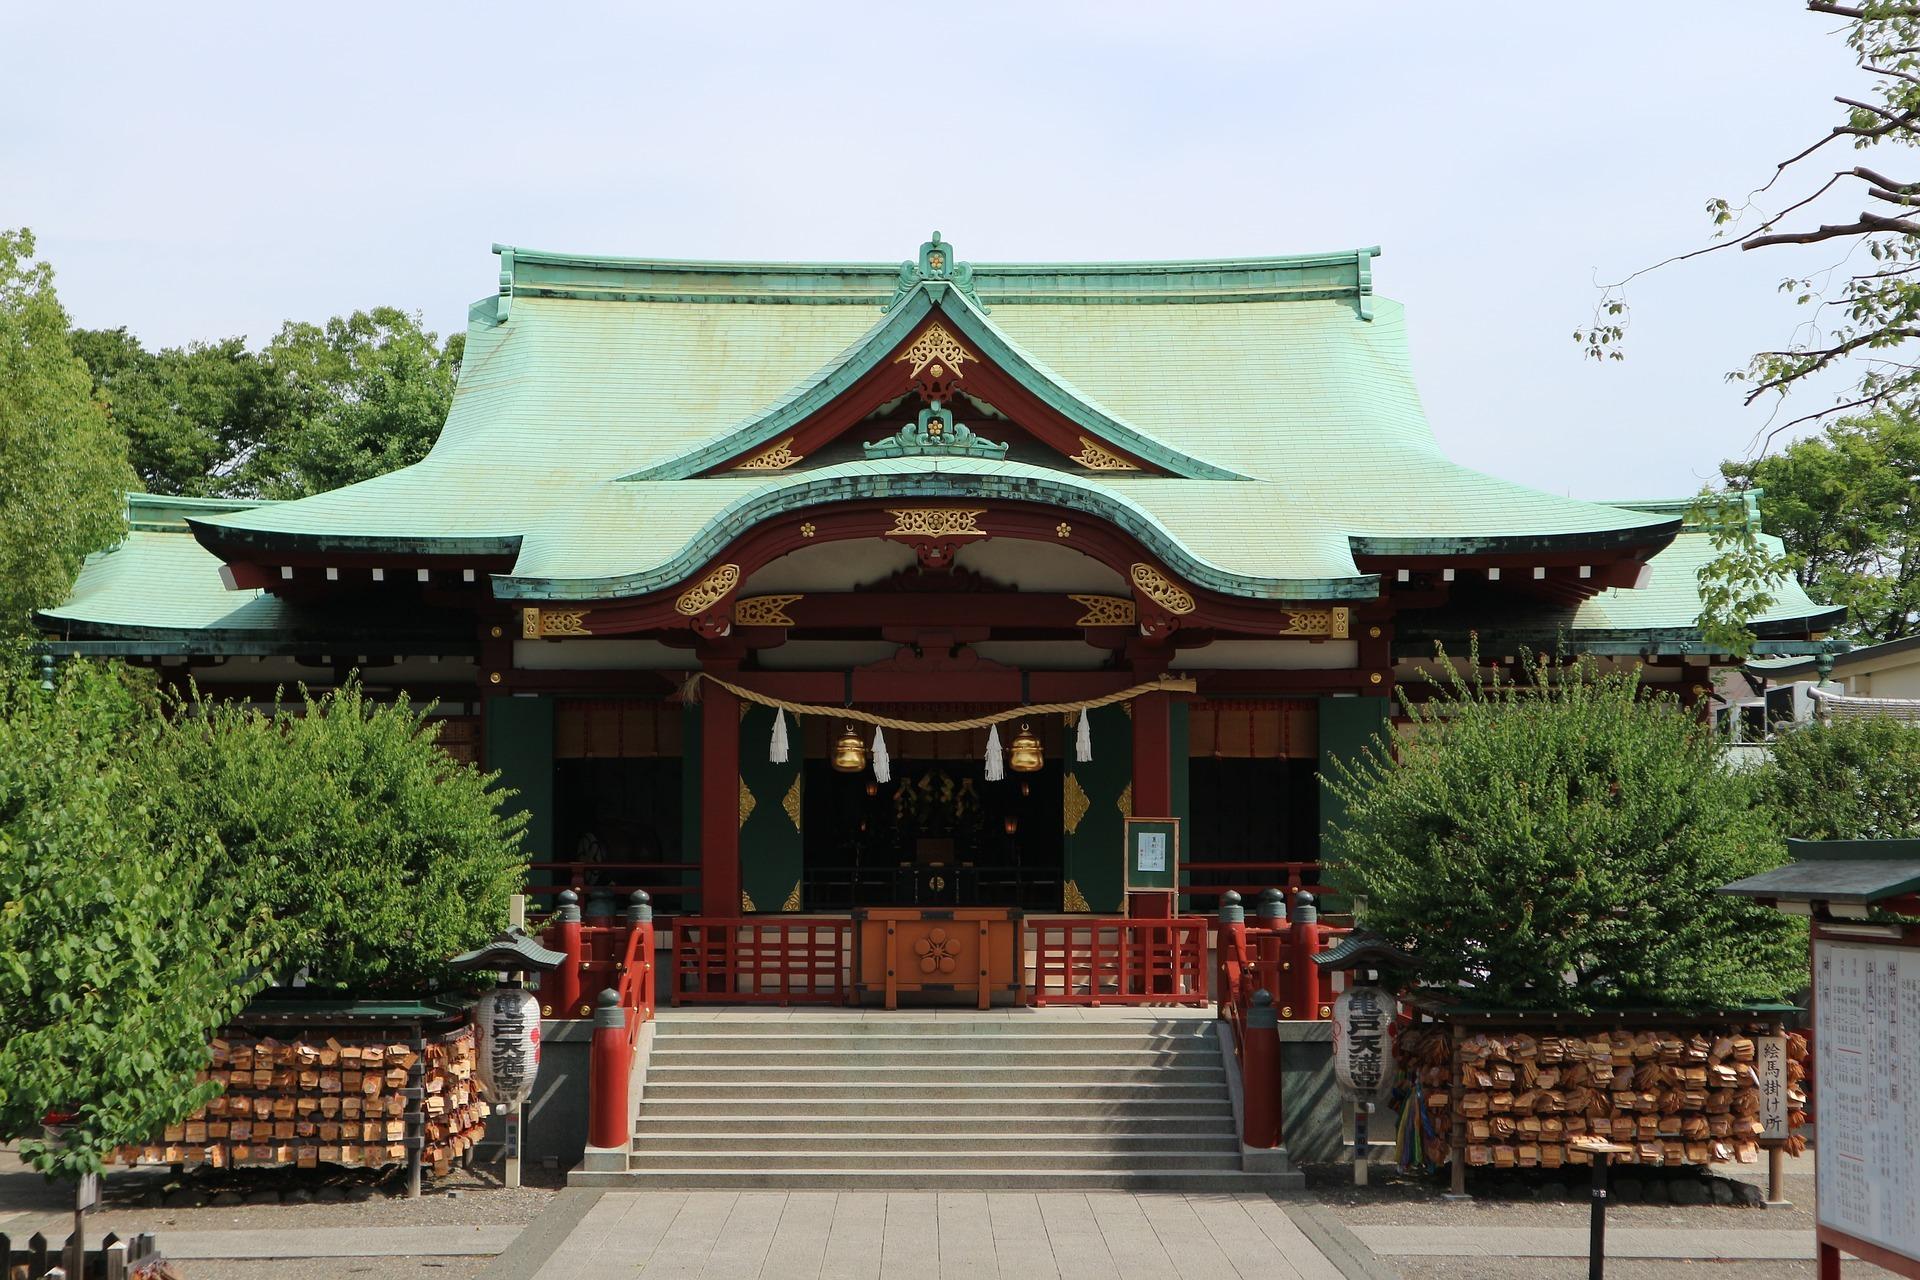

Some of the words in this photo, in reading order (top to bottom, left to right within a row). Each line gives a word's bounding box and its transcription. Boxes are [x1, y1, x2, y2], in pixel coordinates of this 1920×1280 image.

[1347, 990, 1383, 1090] 亀戸天満宮
[1763, 1042, 1783, 1132] 絵馬掛け所
